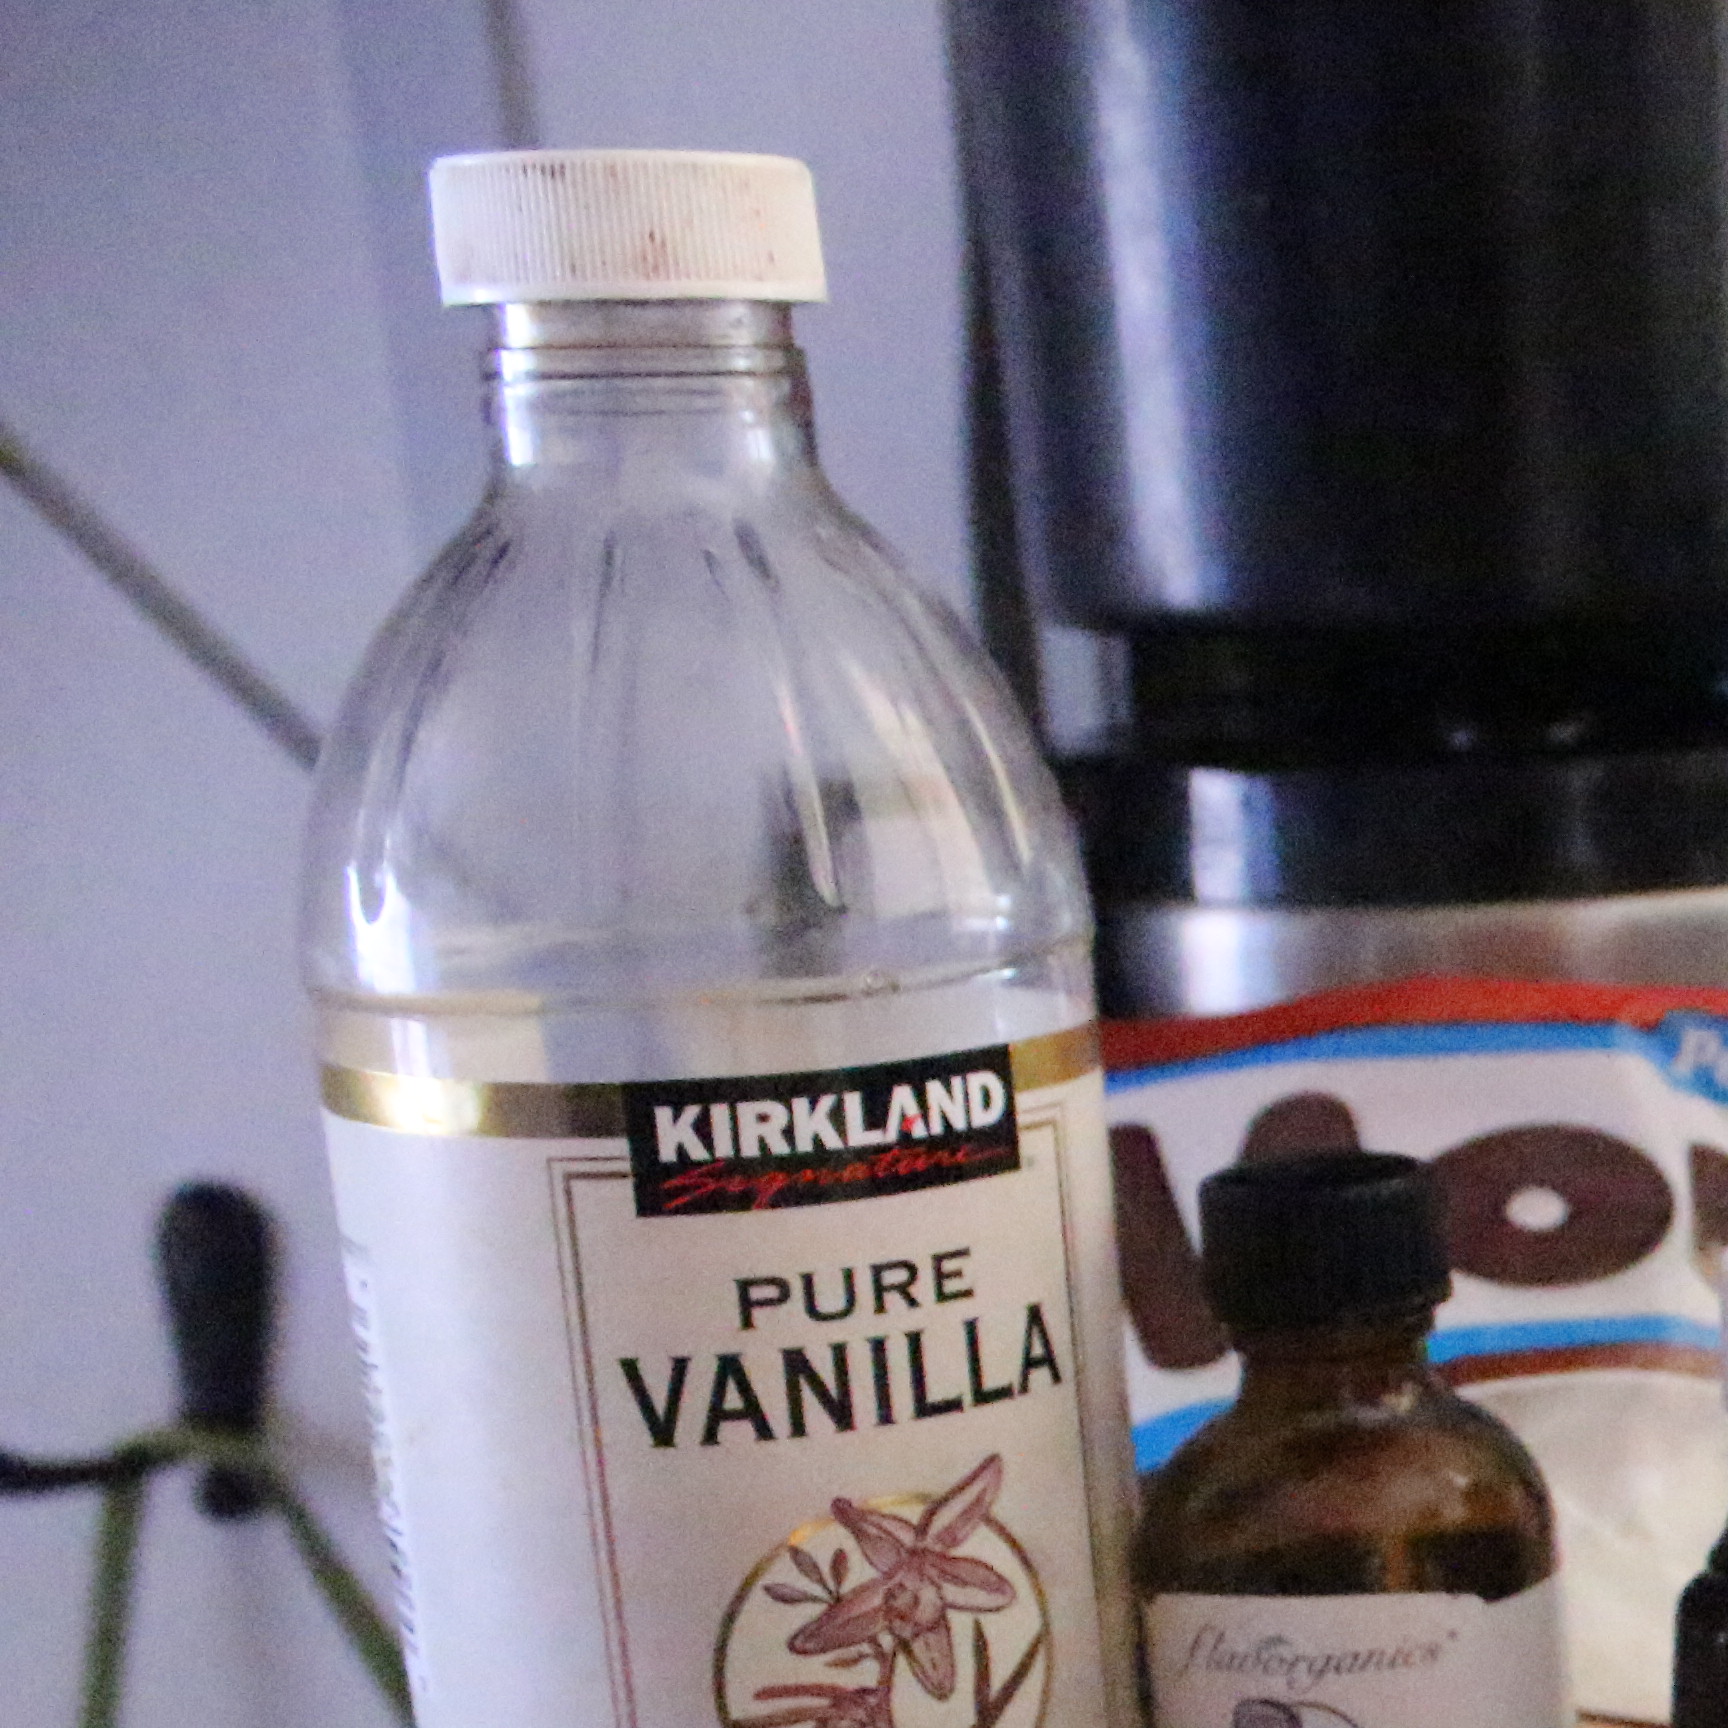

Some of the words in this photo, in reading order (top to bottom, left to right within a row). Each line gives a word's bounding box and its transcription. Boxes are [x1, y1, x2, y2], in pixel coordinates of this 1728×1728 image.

[653, 1070, 1006, 1164] KIRKLAND
[733, 1246, 976, 1331] PURE
[618, 1302, 1064, 1449] VANILLA
